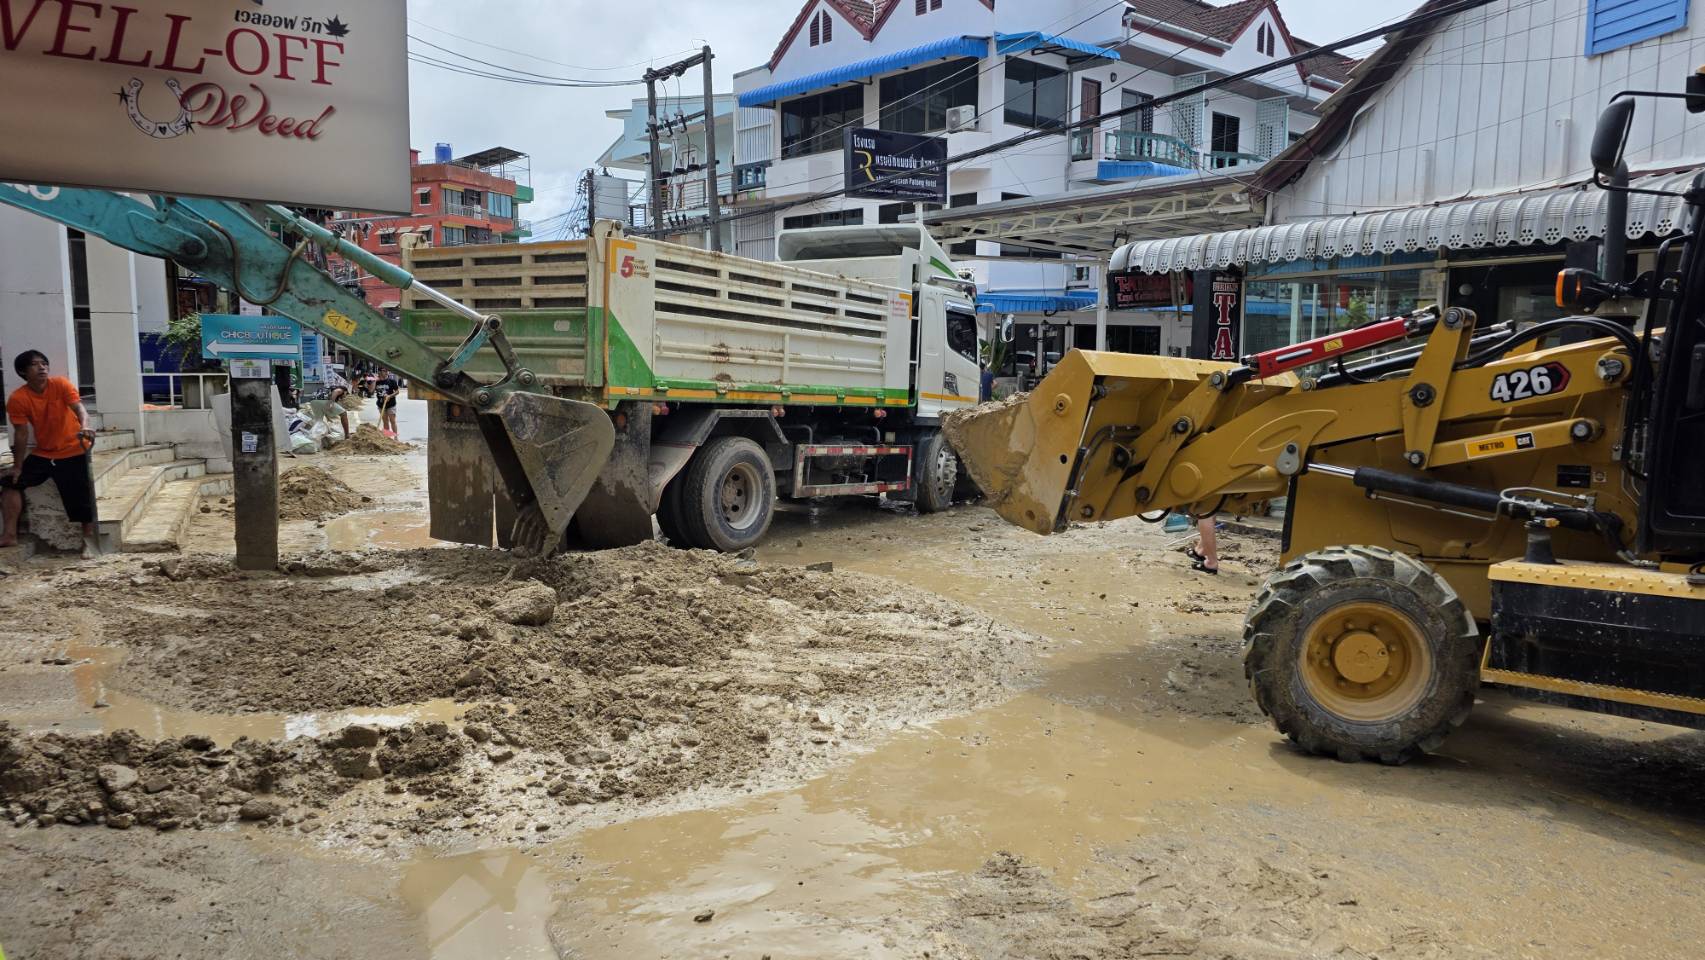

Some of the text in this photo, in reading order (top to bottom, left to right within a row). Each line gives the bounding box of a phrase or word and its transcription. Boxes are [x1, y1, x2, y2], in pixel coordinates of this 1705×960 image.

[180, 82, 335, 139] Weed
[620, 255, 635, 278] 5
[1491, 366, 1552, 402] 426
[1479, 440, 1505, 452] METRO
